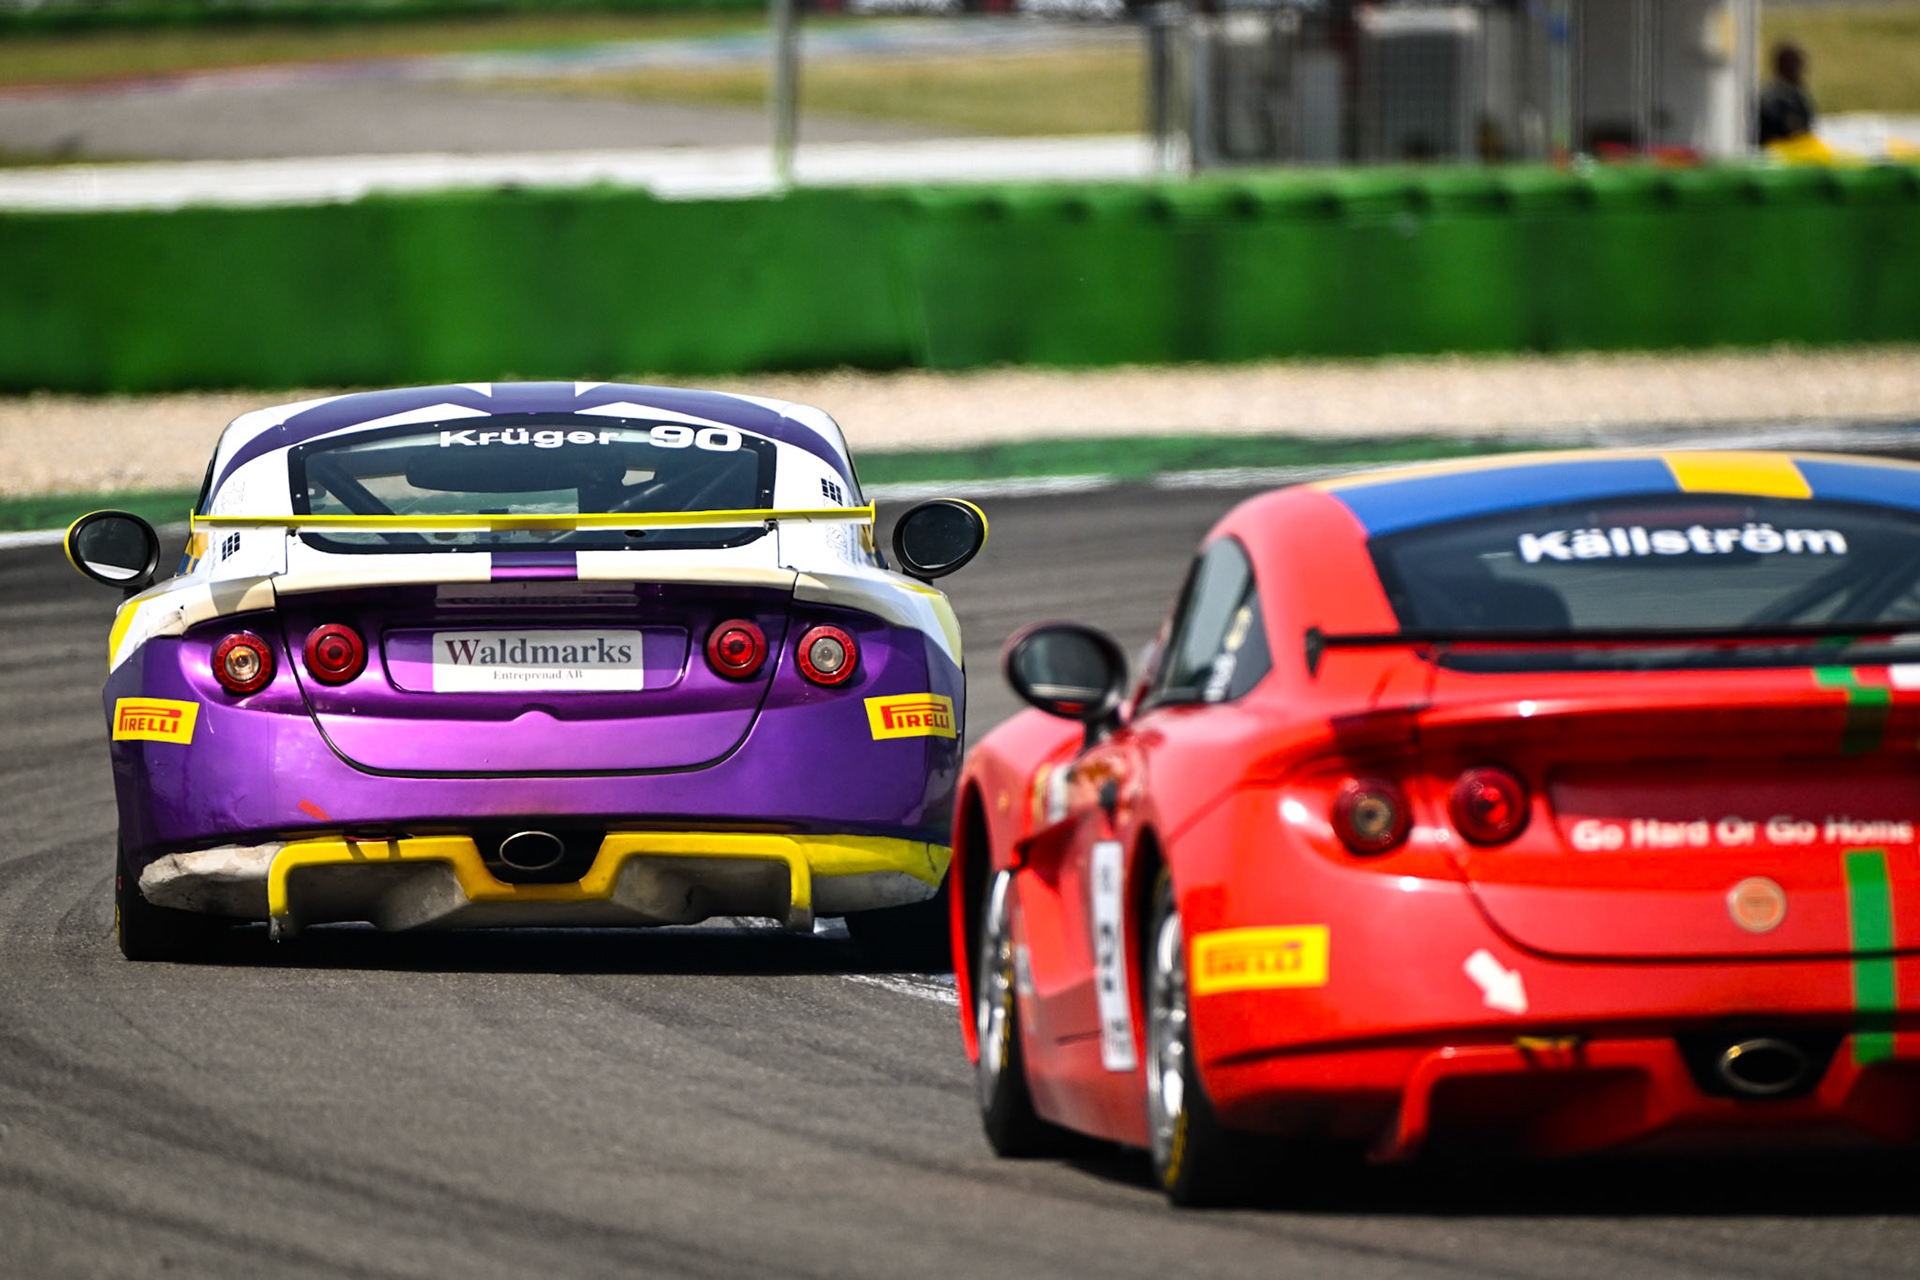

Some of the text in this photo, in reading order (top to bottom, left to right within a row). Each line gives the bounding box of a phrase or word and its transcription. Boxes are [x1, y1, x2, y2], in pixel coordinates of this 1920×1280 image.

[439, 425, 743, 452] Krüger 90
[1518, 523, 1847, 563] Källström
[444, 638, 632, 665] Waldmarks
[493, 669, 583, 682] Entreprenad AB
[119, 706, 182, 734] PIRELLI
[880, 702, 950, 730] PIRELLI
[1571, 814, 1914, 851] Go Hard Or Go Home
